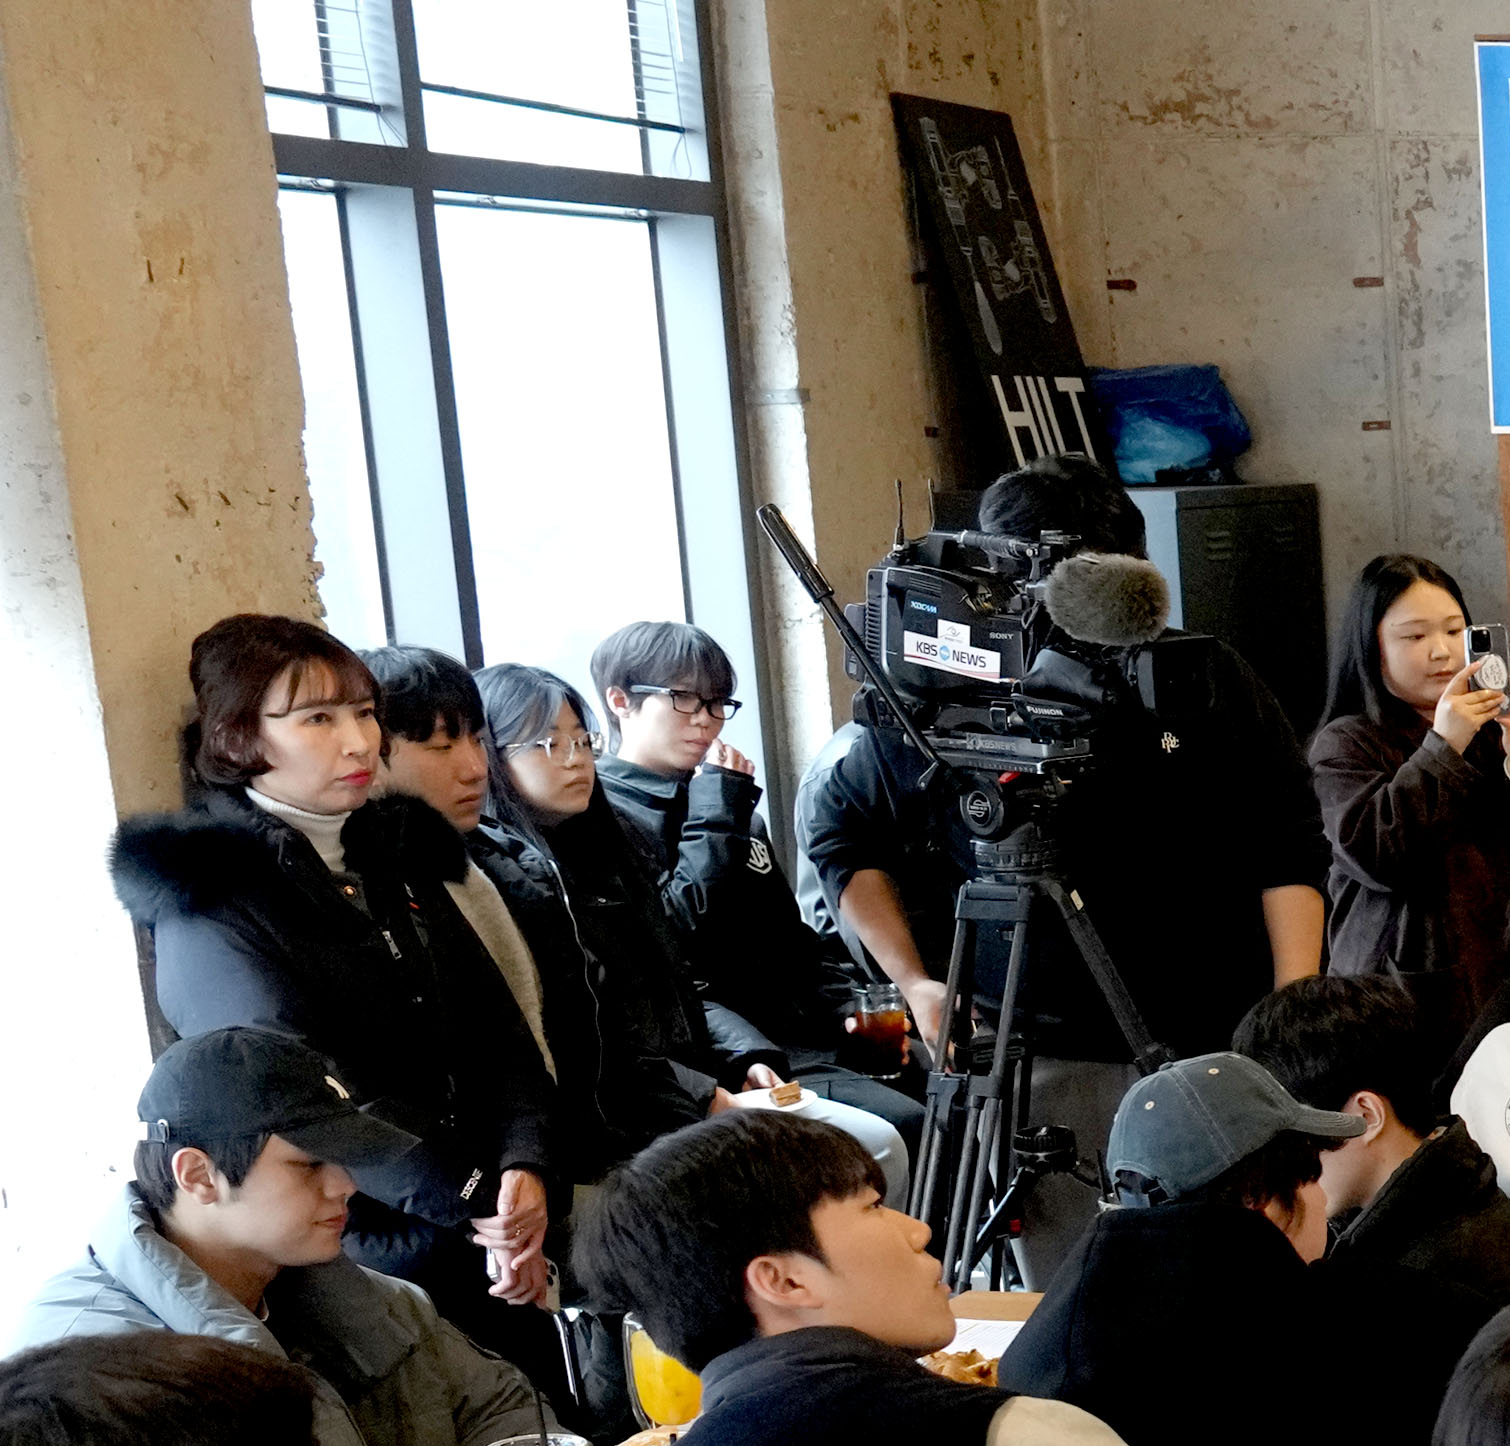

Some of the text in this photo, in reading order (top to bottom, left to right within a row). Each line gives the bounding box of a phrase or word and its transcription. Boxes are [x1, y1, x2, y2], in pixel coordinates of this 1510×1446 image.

[990, 374, 1099, 468] HILT
[989, 631, 1014, 640] SONY
[916, 641, 987, 669] KBS NEWS
[1026, 704, 1065, 717] FUJINON
